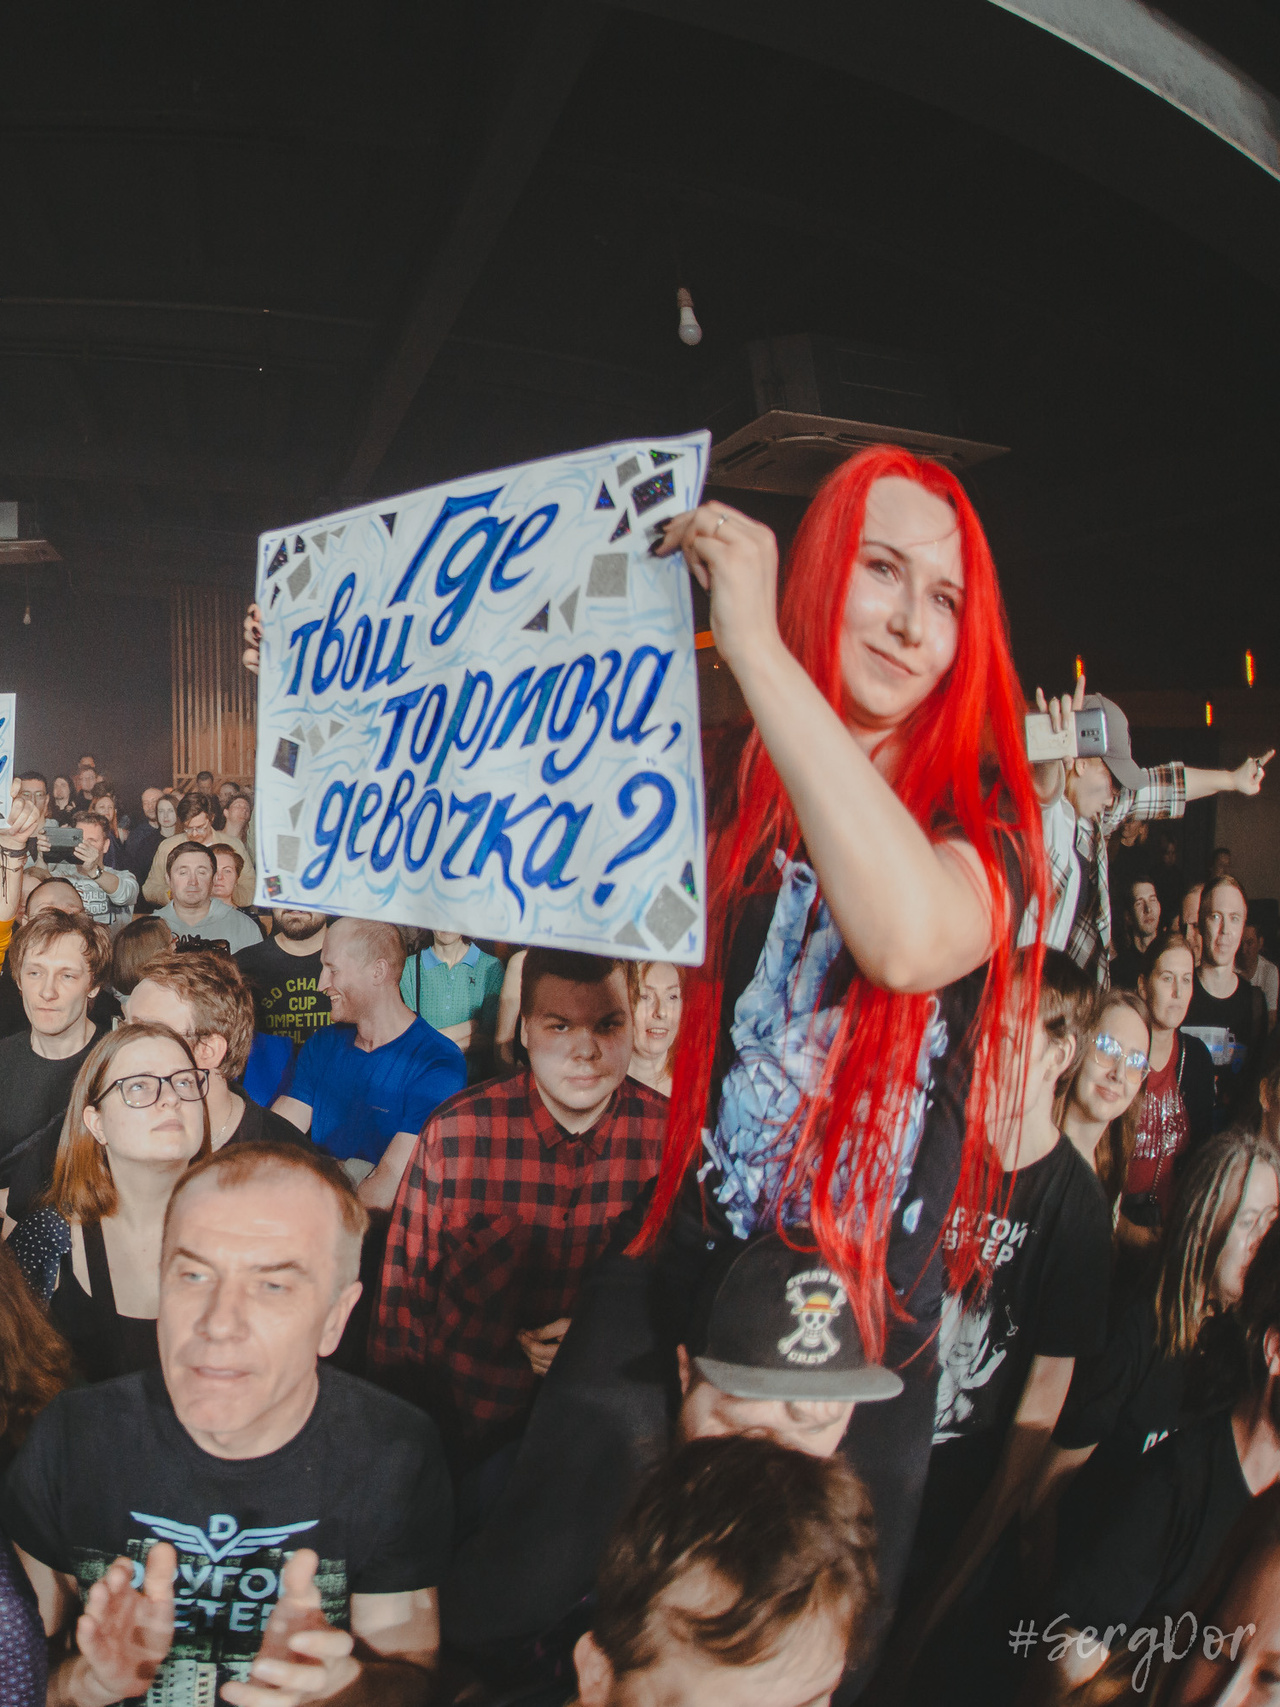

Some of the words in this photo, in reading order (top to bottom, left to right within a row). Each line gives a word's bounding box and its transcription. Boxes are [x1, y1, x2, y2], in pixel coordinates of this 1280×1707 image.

[388, 485, 559, 646] Где
[286, 572, 415, 696] твои
[375, 645, 683, 787] тормоза,
[300, 770, 677, 923] девочка?
[285, 977, 320, 993] CHA
[288, 996, 317, 1012] CUP
[786, 1349, 829, 1365] CREW
